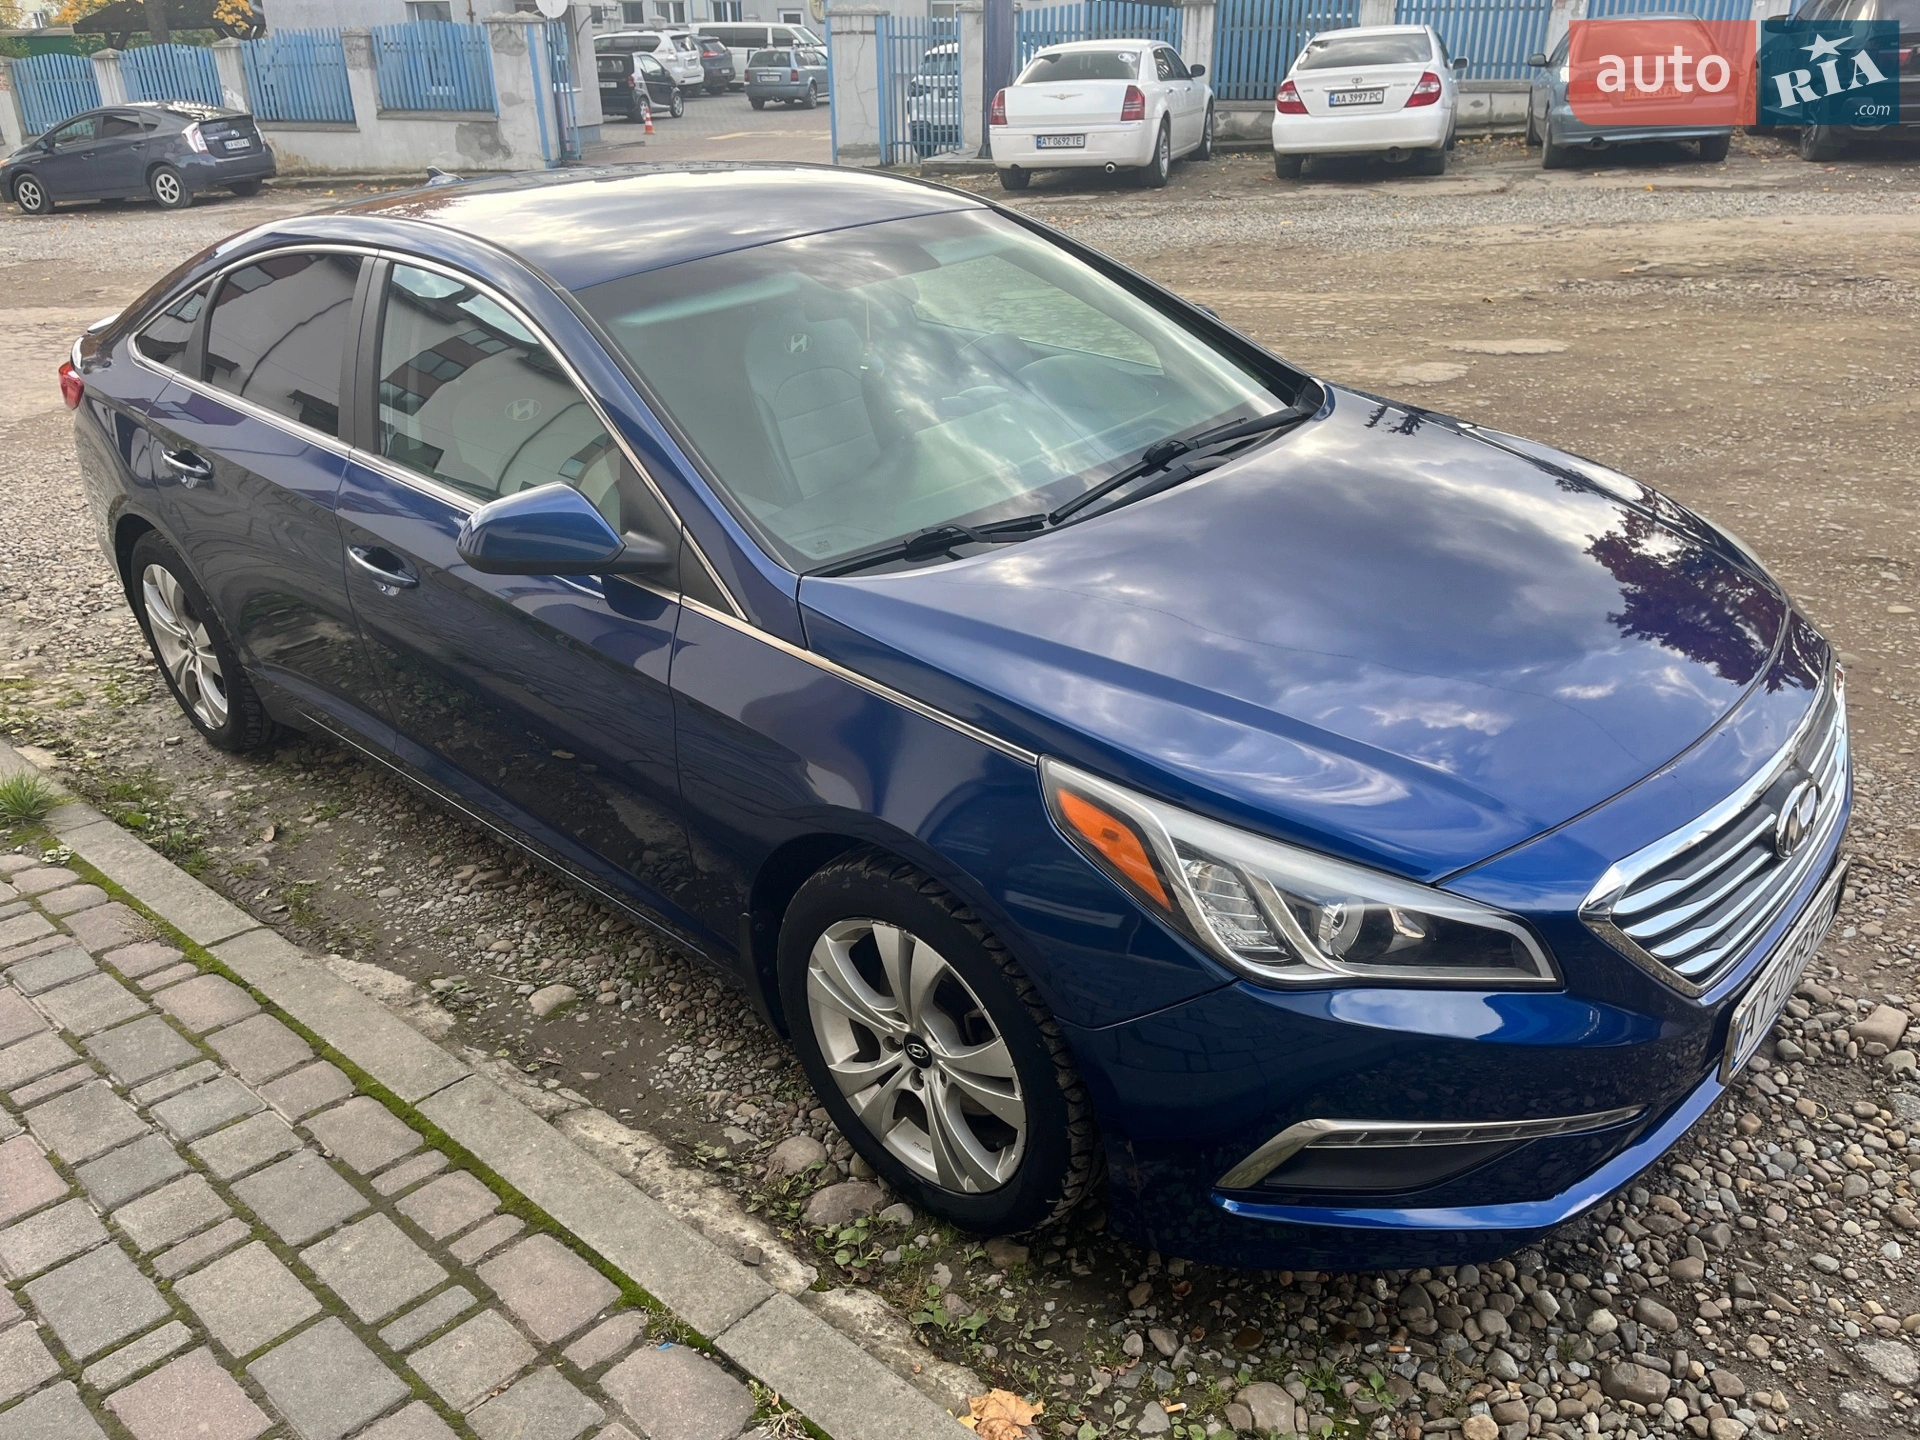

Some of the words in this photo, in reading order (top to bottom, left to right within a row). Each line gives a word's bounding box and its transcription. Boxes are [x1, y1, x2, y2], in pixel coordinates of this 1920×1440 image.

[1335, 95, 1347, 103] AA
[1349, 93, 1367, 102] 3997
[1369, 92, 1381, 101] PC
[1041, 137, 1052, 146] AT
[1053, 137, 1070, 146] 0692
[1072, 136, 1082, 145] IE
[1740, 977, 1776, 1050] AT
[1774, 922, 1817, 1002] 0193
